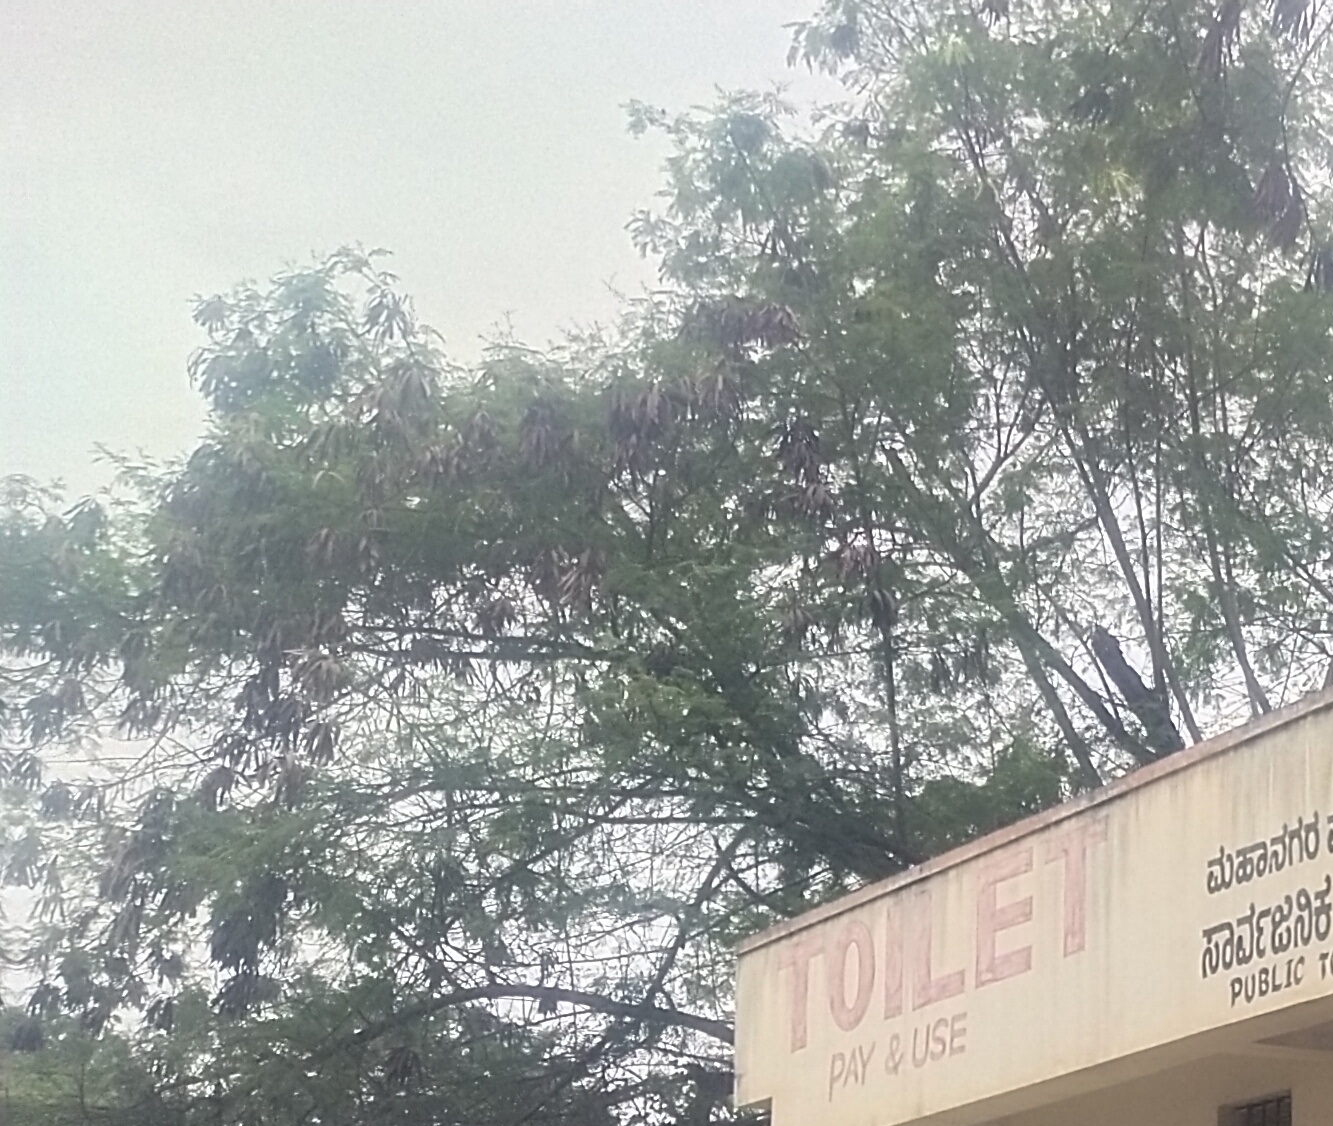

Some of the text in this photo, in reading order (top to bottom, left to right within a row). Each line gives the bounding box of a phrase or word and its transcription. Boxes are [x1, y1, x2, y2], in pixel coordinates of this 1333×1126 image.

[1206, 810, 1321, 895] ಮಹಾನಗರ
[776, 814, 1111, 1054] TOILET
[1201, 874, 1333, 979] ಸಾರ್ವಜನಿಕ
[1229, 955, 1305, 1008] PUBLIC
[829, 1012, 968, 1102] PAY & USE
